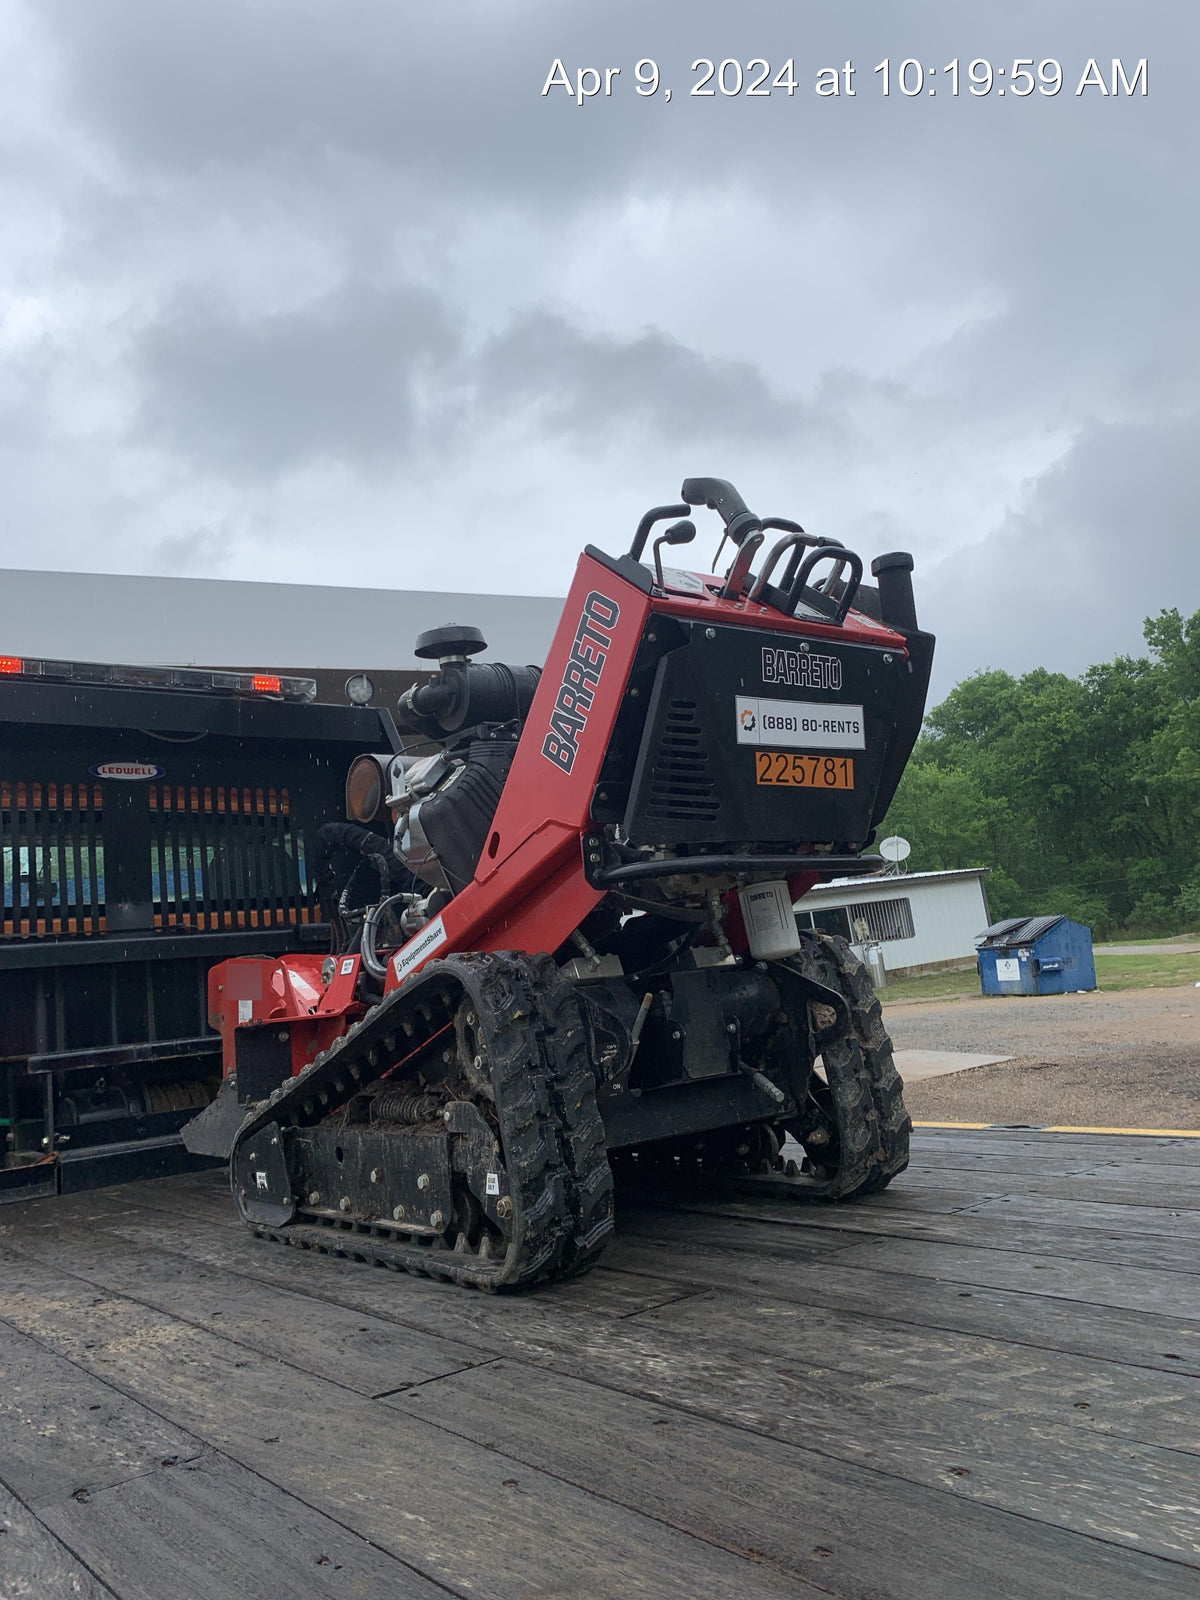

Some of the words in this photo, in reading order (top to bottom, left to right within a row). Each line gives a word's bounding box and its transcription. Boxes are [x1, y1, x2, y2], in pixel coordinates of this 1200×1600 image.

[541, 589, 620, 776] BARRETO
[761, 647, 843, 690] BARRETO
[762, 714, 798, 732] (888)
[802, 718, 860, 734] 80-RENTS
[101, 766, 154, 775] LEDWELL
[757, 753, 849, 787] 225781
[401, 927, 443, 968] EquipmentShare
